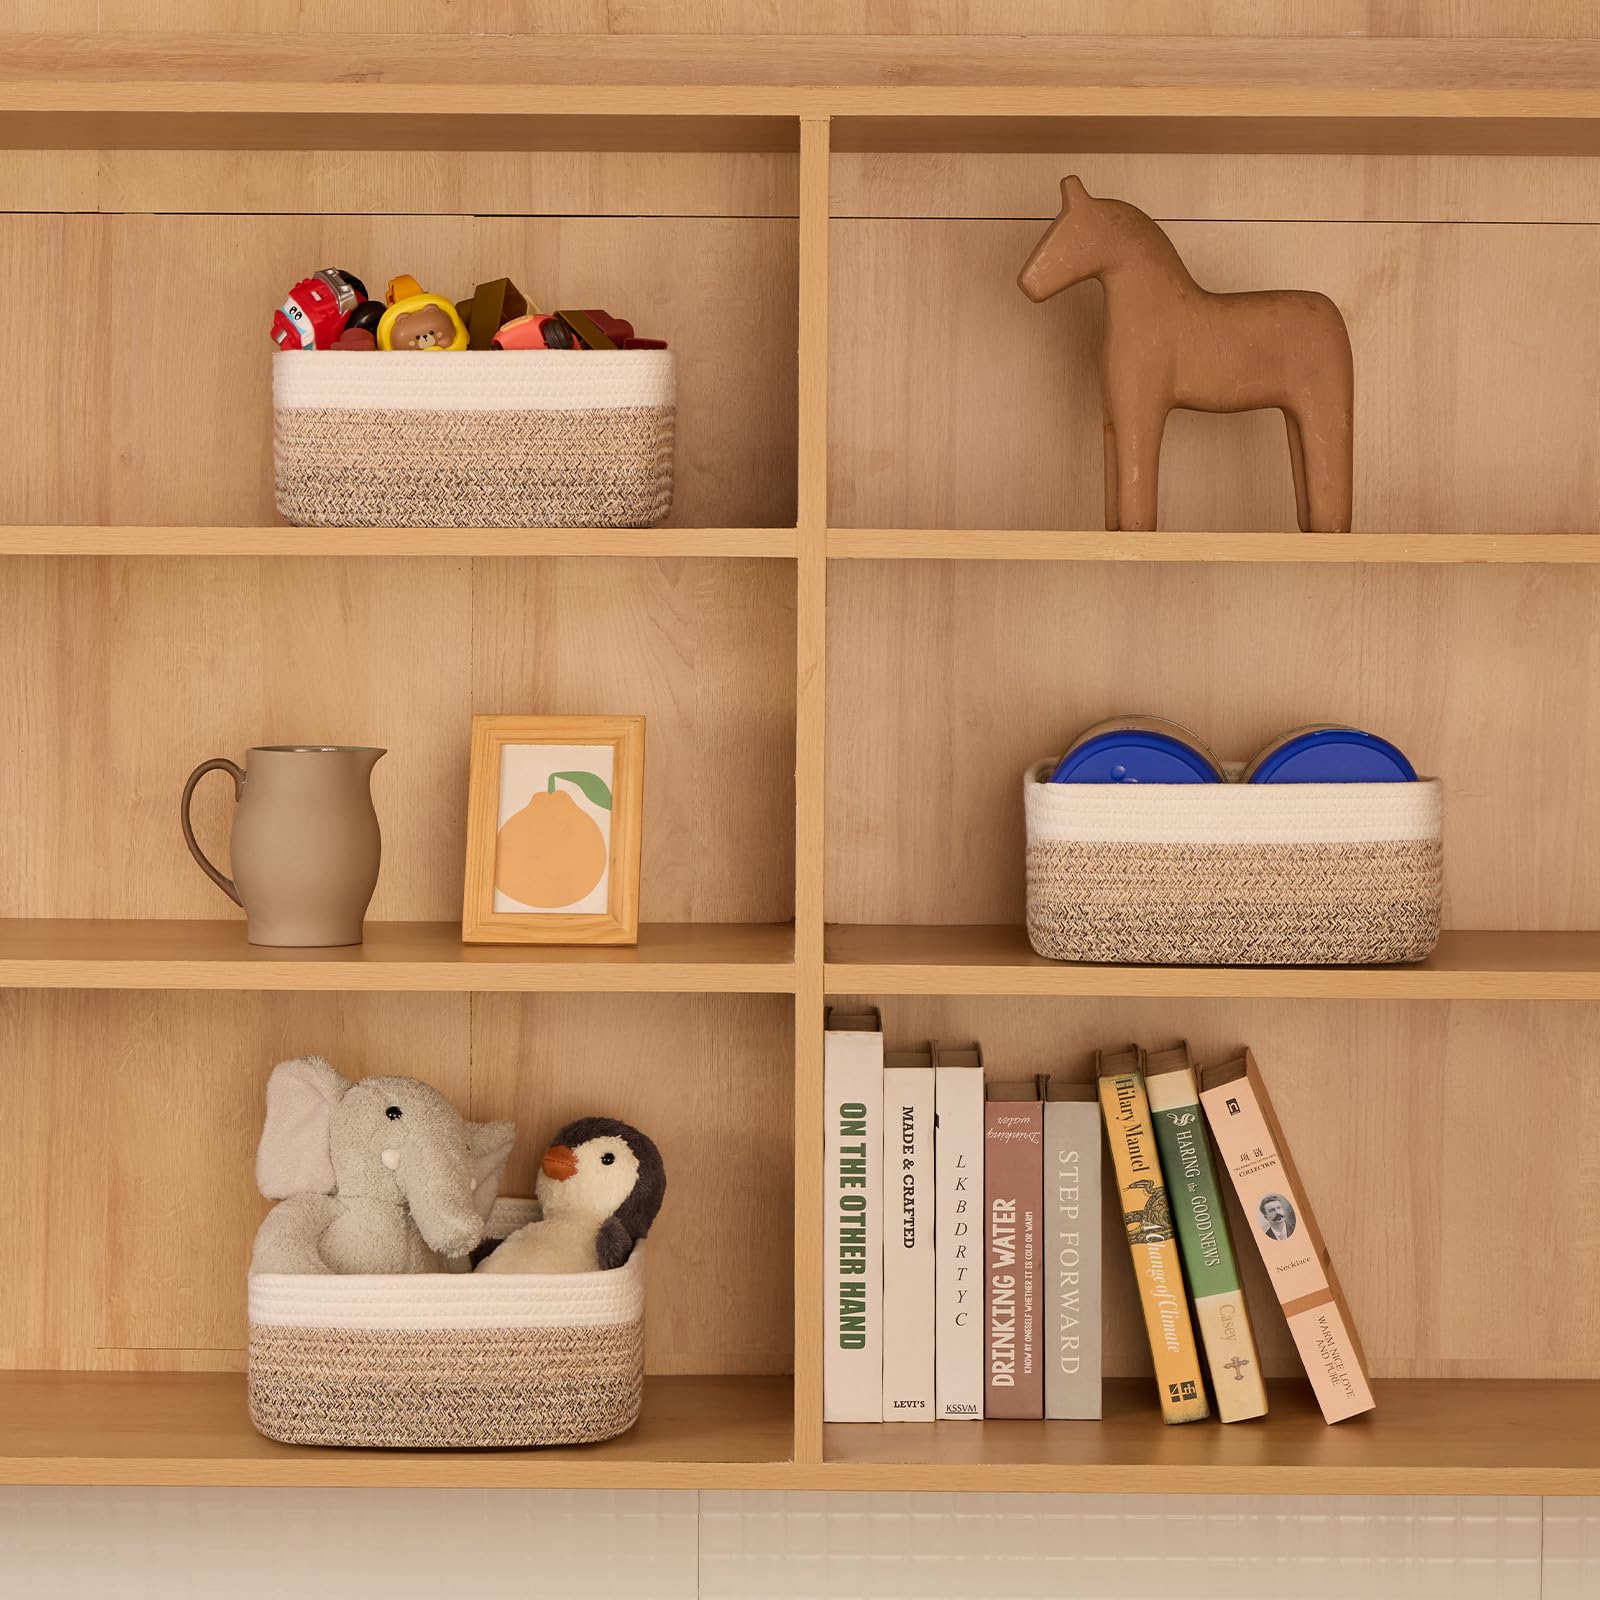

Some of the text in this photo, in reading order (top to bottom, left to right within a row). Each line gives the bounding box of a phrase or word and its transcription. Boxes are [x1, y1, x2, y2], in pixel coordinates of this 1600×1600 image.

[985, 1128, 1041, 1145] Drinking
[997, 1116, 1031, 1128] water
[1115, 1077, 1150, 1172] Hilary Mantel
[902, 1106, 915, 1249] MADE & CRAFTED
[1238, 1160, 1276, 1177] COLLECTION
[839, 1103, 867, 1350] ON THE OTHER HAND
[1058, 1151, 1080, 1374] STEP FORWARD
[1144, 1233, 1167, 1283] Change
[1277, 1256, 1312, 1273] Necklace
[991, 1198, 1016, 1387] DRINKING WATER
[1024, 1211, 1033, 1374] KNOW BY ONESELF WHETHER IT IS COLD OR WARM
[1151, 1284, 1176, 1301] of
[1158, 1300, 1180, 1353] Climate
[1219, 1304, 1237, 1341] Casey
[1316, 1338, 1341, 1387] AND PURE
[1318, 1315, 1355, 1398] WARM NICE LOVE
[894, 1400, 925, 1408] LEVI'S
[946, 1404, 977, 1412] KSSVM
